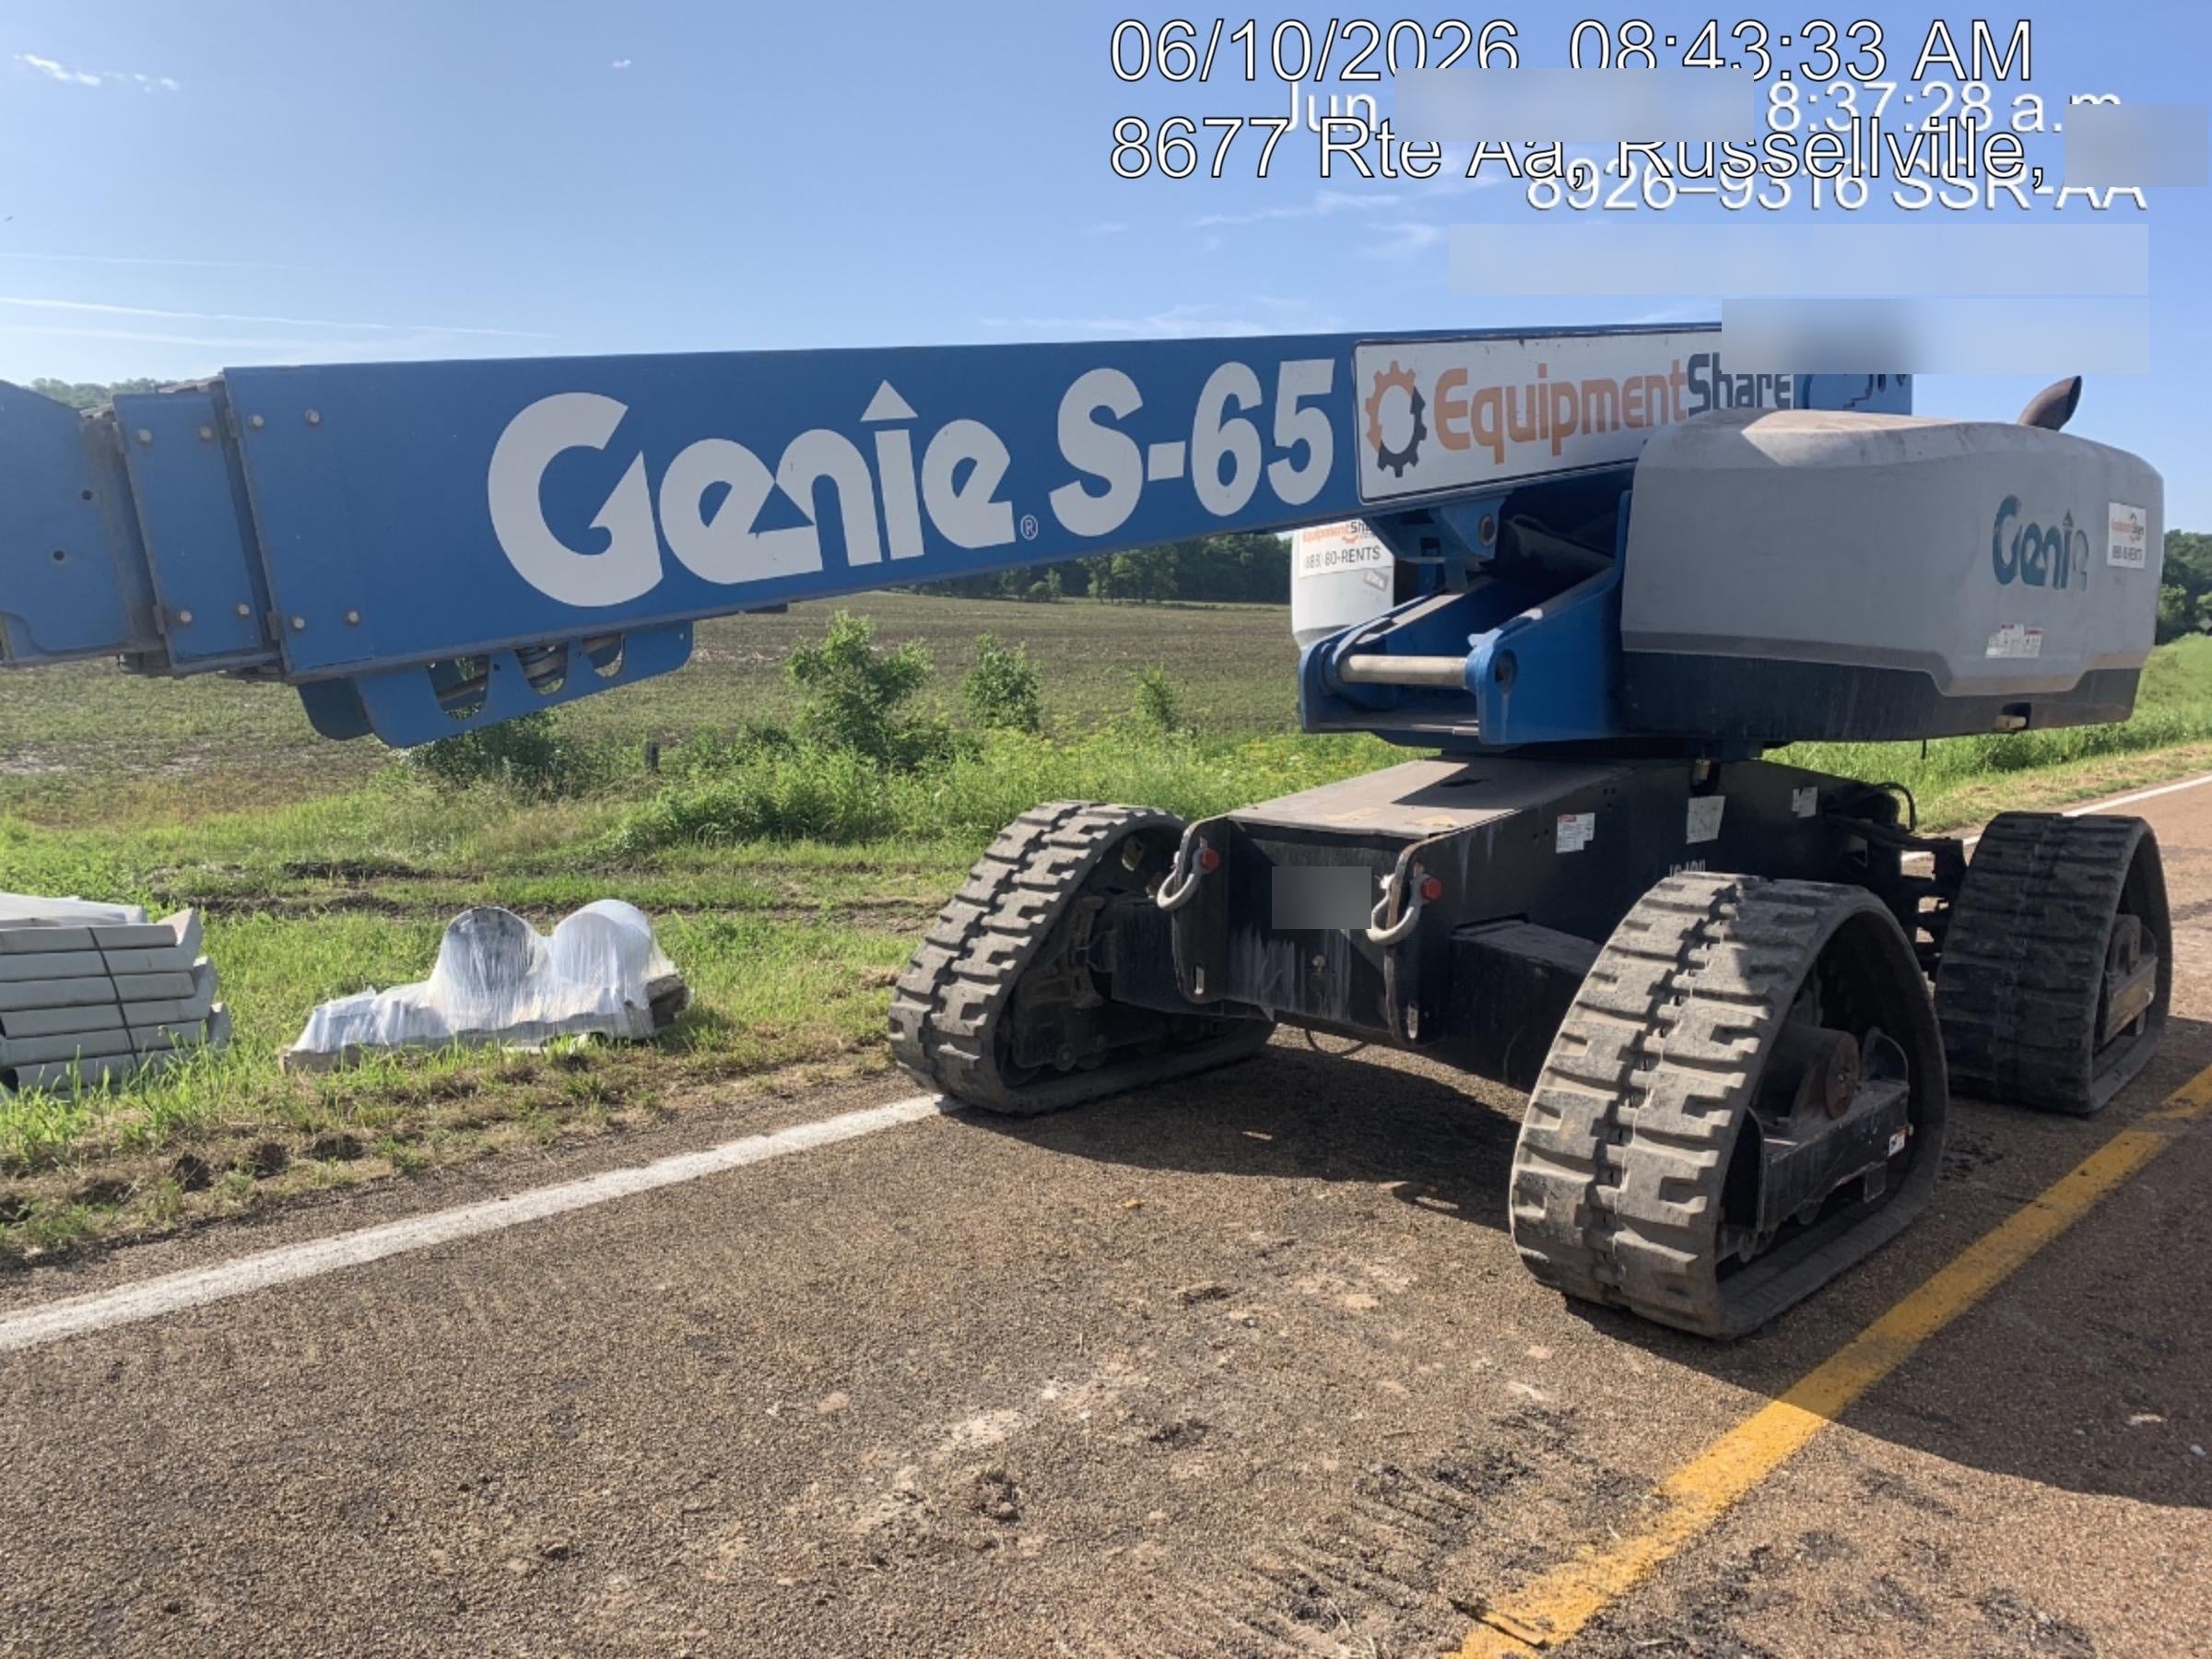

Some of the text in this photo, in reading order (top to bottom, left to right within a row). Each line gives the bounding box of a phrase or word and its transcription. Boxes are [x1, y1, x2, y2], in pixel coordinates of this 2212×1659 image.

[487, 379, 1017, 607] Genie
[1049, 359, 1335, 537] S-65
[1434, 352, 1792, 464] EquipmentShare
